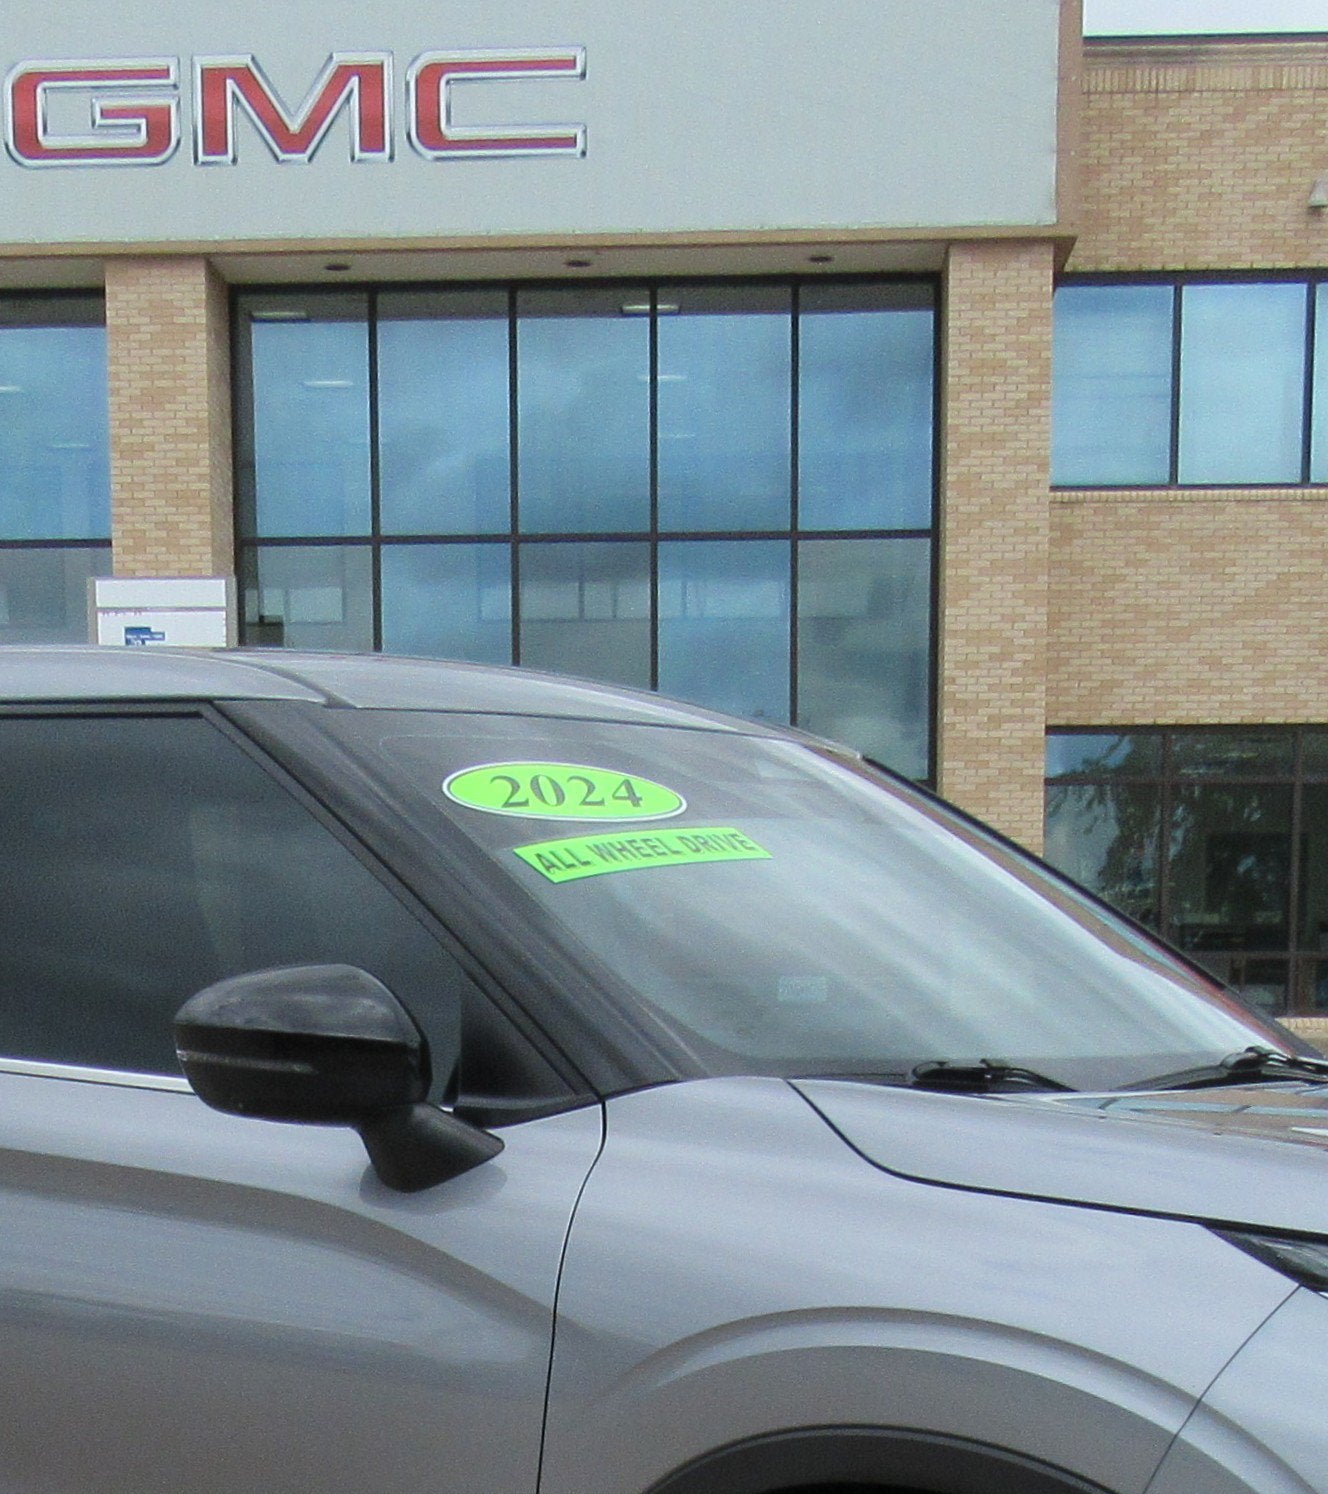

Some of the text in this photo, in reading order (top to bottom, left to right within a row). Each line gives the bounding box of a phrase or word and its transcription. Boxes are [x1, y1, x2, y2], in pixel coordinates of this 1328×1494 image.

[3, 46, 588, 169] GMC
[489, 774, 643, 808] 2024
[534, 833, 759, 874] ALL WHEEL DRIVE
